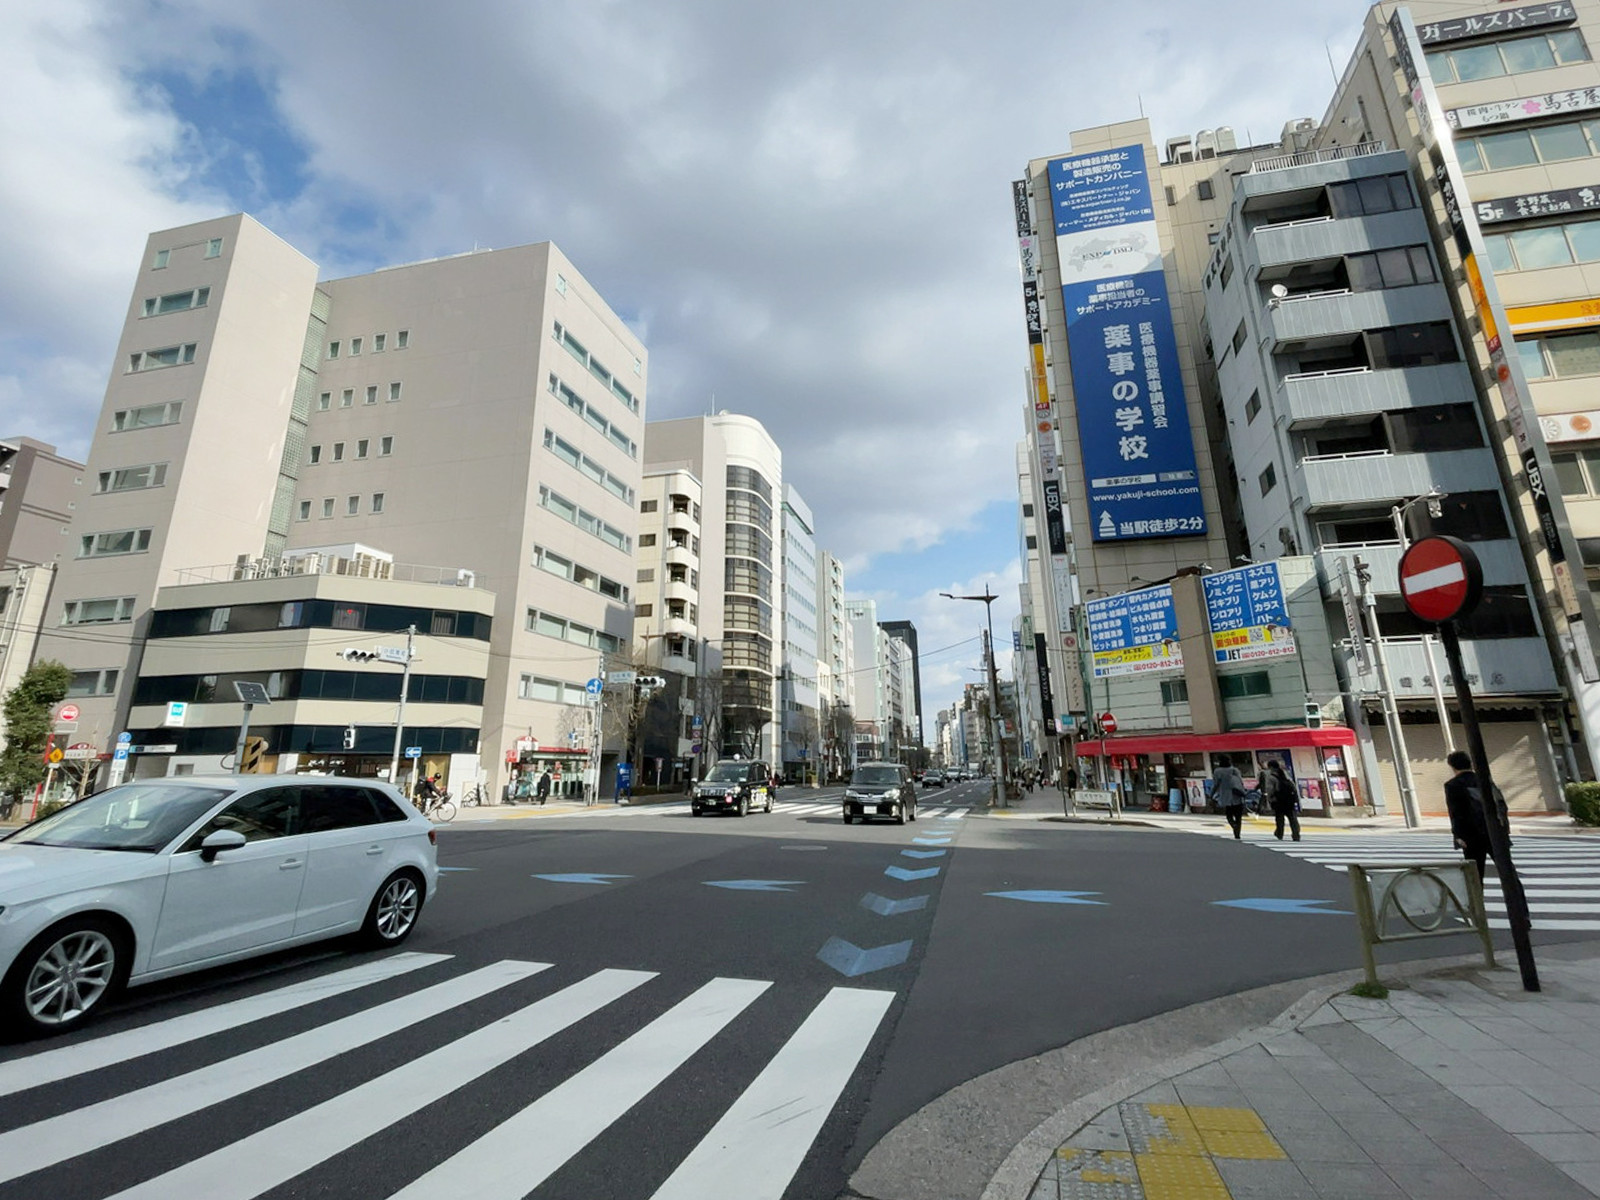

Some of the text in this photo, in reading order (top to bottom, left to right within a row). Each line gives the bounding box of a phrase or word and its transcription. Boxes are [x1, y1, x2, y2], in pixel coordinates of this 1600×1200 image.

[1422, 4, 1572, 40] ガールズバー 7F
[1477, 202, 1504, 221] 5F
[1076, 297, 1161, 315] サポートアカデミー
[1103, 323, 1149, 461] 薬事の学校
[1525, 458, 1546, 500] UBX
[1046, 485, 1060, 513] UBX
[1092, 486, 1199, 502] www.yakuji-school.com
[1120, 515, 1204, 535] 当駅徒歩2分
[1248, 565, 1273, 578] ネズミ
[1205, 572, 1243, 588] トコジラミ
[1209, 595, 1240, 609] ゴキブリ
[1252, 589, 1277, 601] ケムシ
[1211, 606, 1242, 620] シロアリ
[1254, 600, 1279, 613] カラス
[1212, 618, 1244, 631] コウモリ
[1256, 613, 1274, 624] ハト
[1227, 649, 1241, 661] JET
